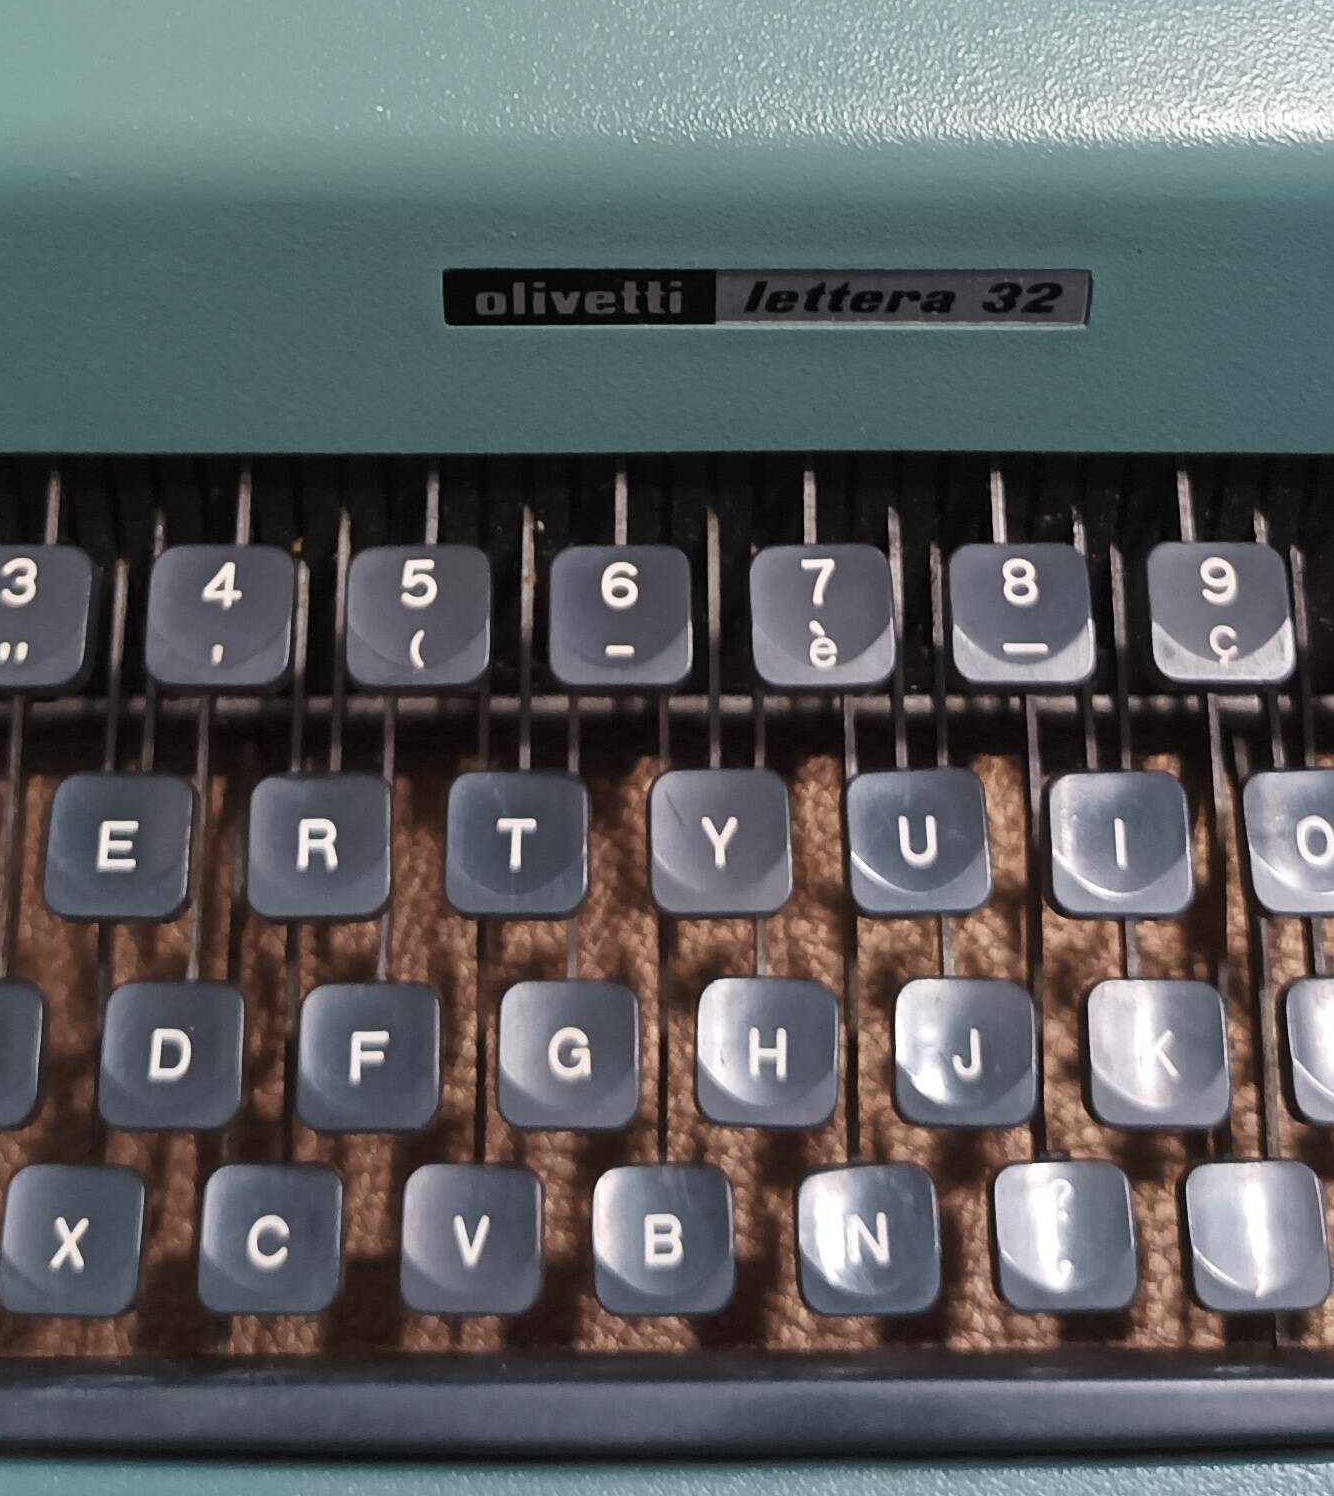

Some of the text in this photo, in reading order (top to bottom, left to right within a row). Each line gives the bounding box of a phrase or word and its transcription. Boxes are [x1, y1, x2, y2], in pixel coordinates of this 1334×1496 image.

[474, 280, 1064, 316] olivetti lettera 32
[202, 561, 242, 610] 4
[400, 558, 438, 608] 5
[600, 561, 639, 609] 6
[800, 558, 836, 605] 7
[1001, 558, 1040, 605] 8
[1199, 557, 1238, 605] 9
[409, 629, 425, 669] (
[809, 620, 838, 668] è
[1208, 624, 1238, 664] ç
[96, 820, 139, 871] E
[296, 818, 338, 871] R
[496, 817, 537, 871] T
[701, 816, 739, 869] Y
[898, 814, 938, 866] U
[1114, 817, 1128, 869] I
[147, 1028, 193, 1083] D
[348, 1030, 390, 1086] F
[547, 1026, 592, 1082] G
[748, 1026, 788, 1083] H
[952, 1027, 981, 1082] J
[1139, 1029, 1180, 1080] K
[48, 1216, 91, 1272] X
[246, 1214, 290, 1271] C
[452, 1214, 490, 1270] V
[642, 1213, 684, 1269] B
[845, 1212, 890, 1266] N
